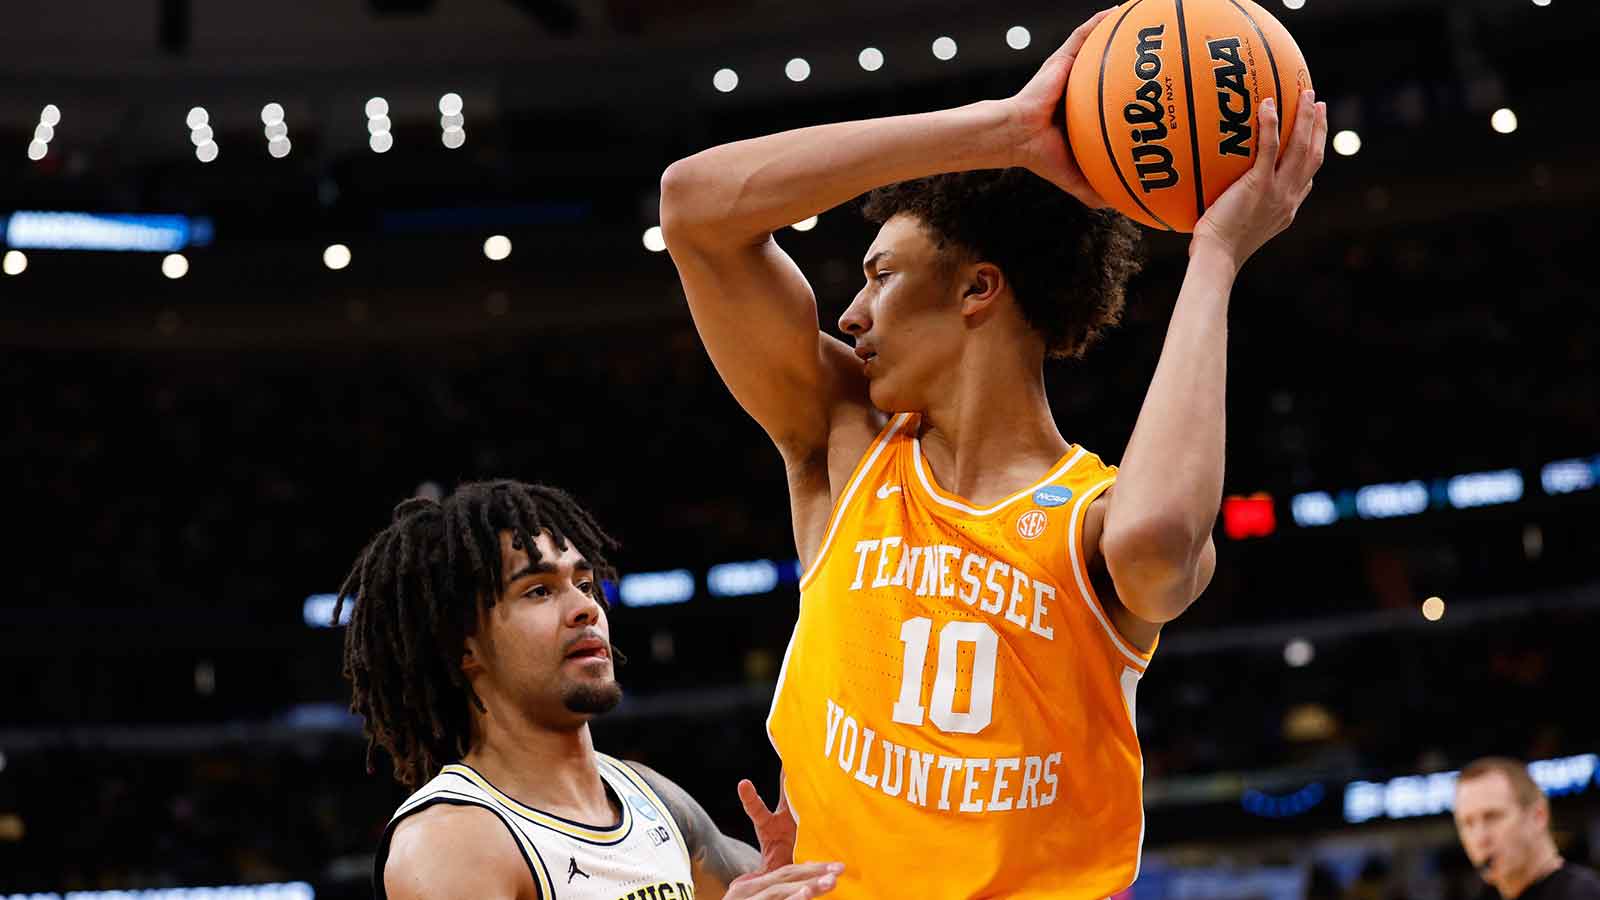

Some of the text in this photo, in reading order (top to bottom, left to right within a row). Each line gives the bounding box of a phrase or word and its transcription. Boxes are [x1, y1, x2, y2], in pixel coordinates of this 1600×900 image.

[1123, 23, 1180, 194] Wilson
[1165, 76, 1177, 129] EVO NXT
[1207, 36, 1252, 158] NCAA
[1019, 511, 1046, 538] SEC
[849, 536, 1056, 640] TENNESSEE
[892, 616, 999, 734] 10
[824, 698, 1062, 813] VOLUNTEERS
